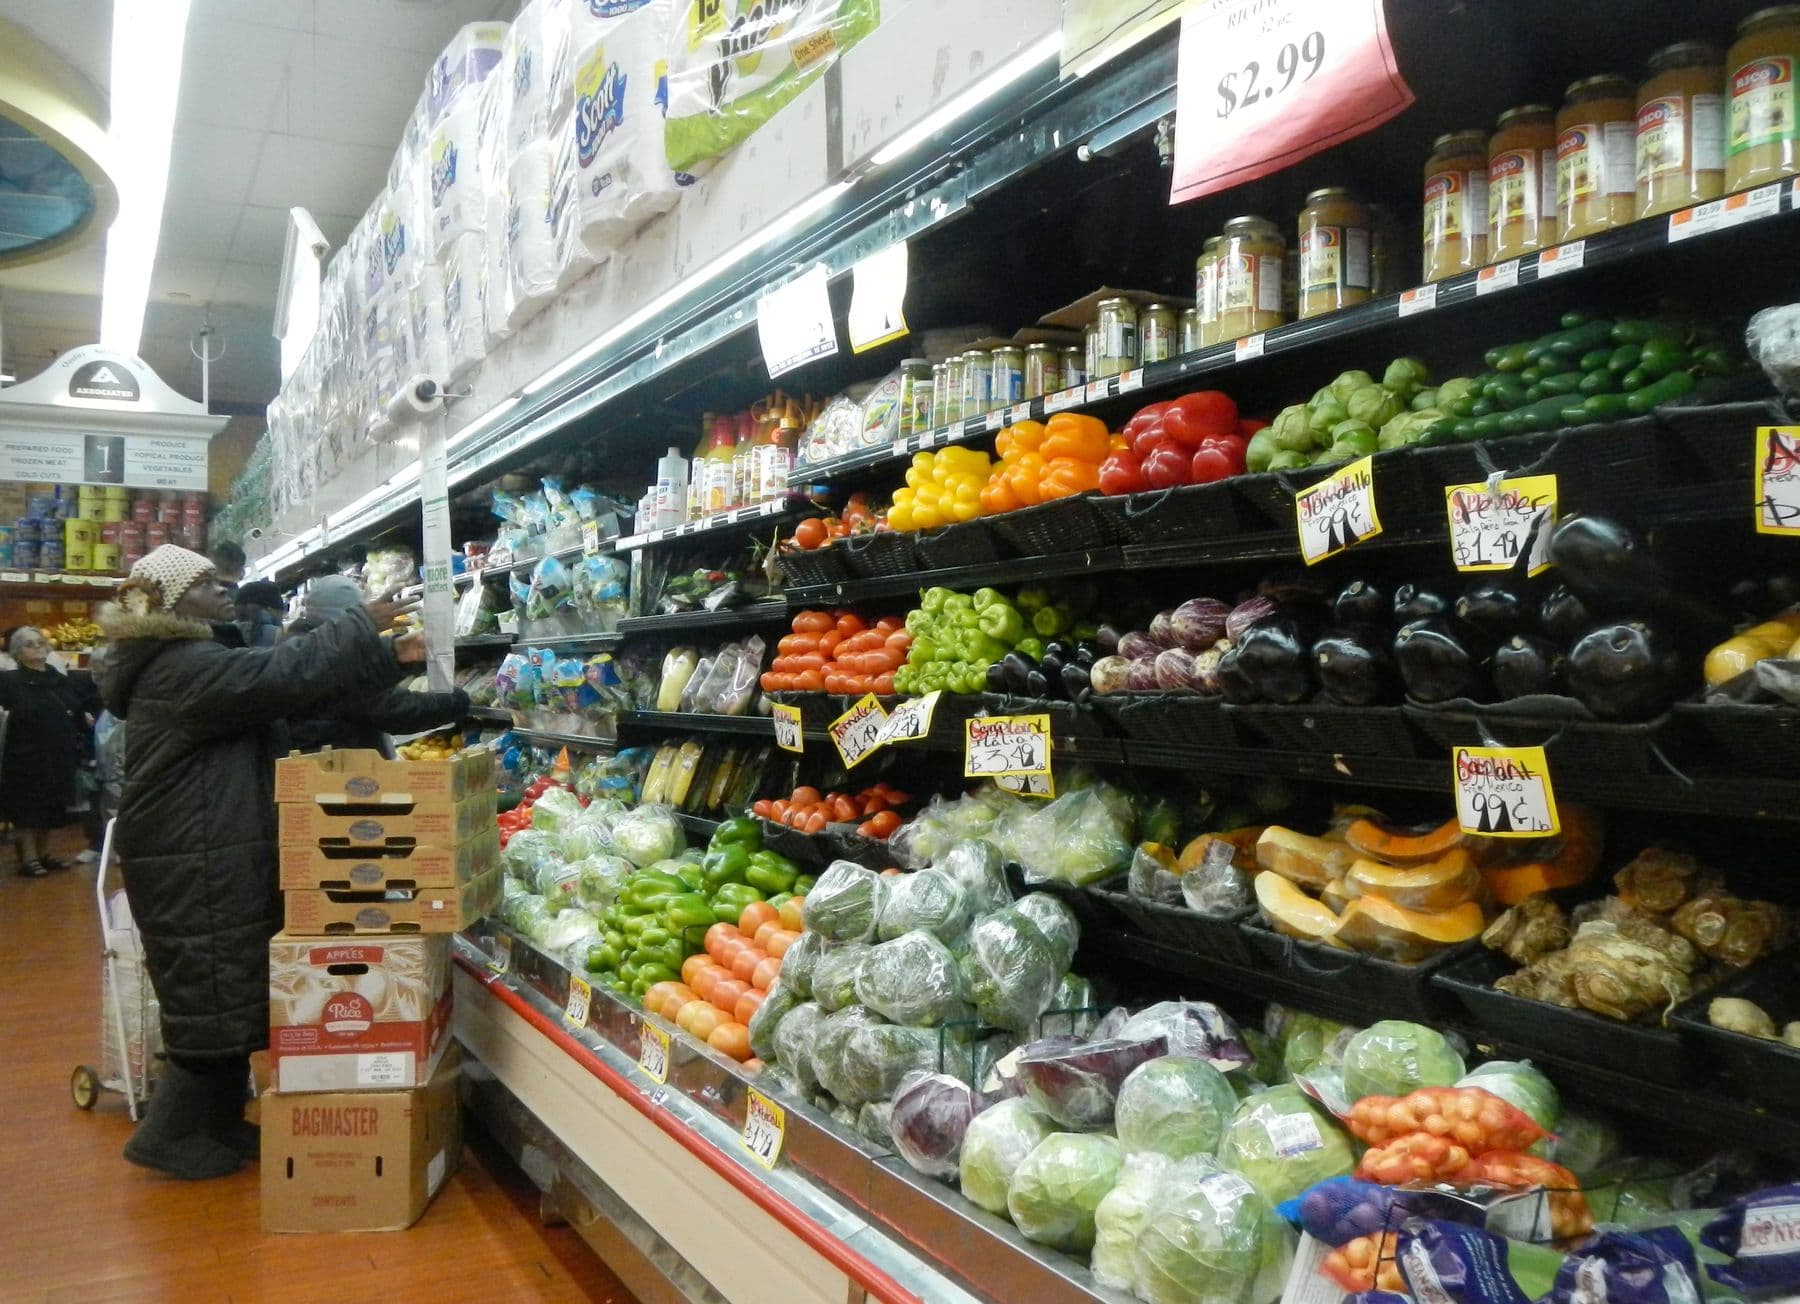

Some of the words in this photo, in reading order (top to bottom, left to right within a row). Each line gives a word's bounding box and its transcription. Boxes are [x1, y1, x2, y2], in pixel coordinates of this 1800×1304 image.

[1217, 31, 1325, 119] $2.99
[1735, 68, 1771, 89] RICO
[580, 62, 618, 148] Scott
[1491, 160, 1517, 177] RICO
[1752, 186, 1778, 201] $2.99
[1697, 204, 1722, 217] $2.99
[150, 440, 187, 449] PRODUCE
[44, 459, 68, 467] MEAT
[96, 443, 112, 474] 1
[142, 465, 193, 474] VEGETABLES
[1455, 530, 1519, 566] $1.49
[968, 742, 1035, 775] $3.49
[326, 949, 365, 961] APPLES
[328, 1002, 362, 1019] Rice
[291, 1106, 379, 1136] BAGMASTER
